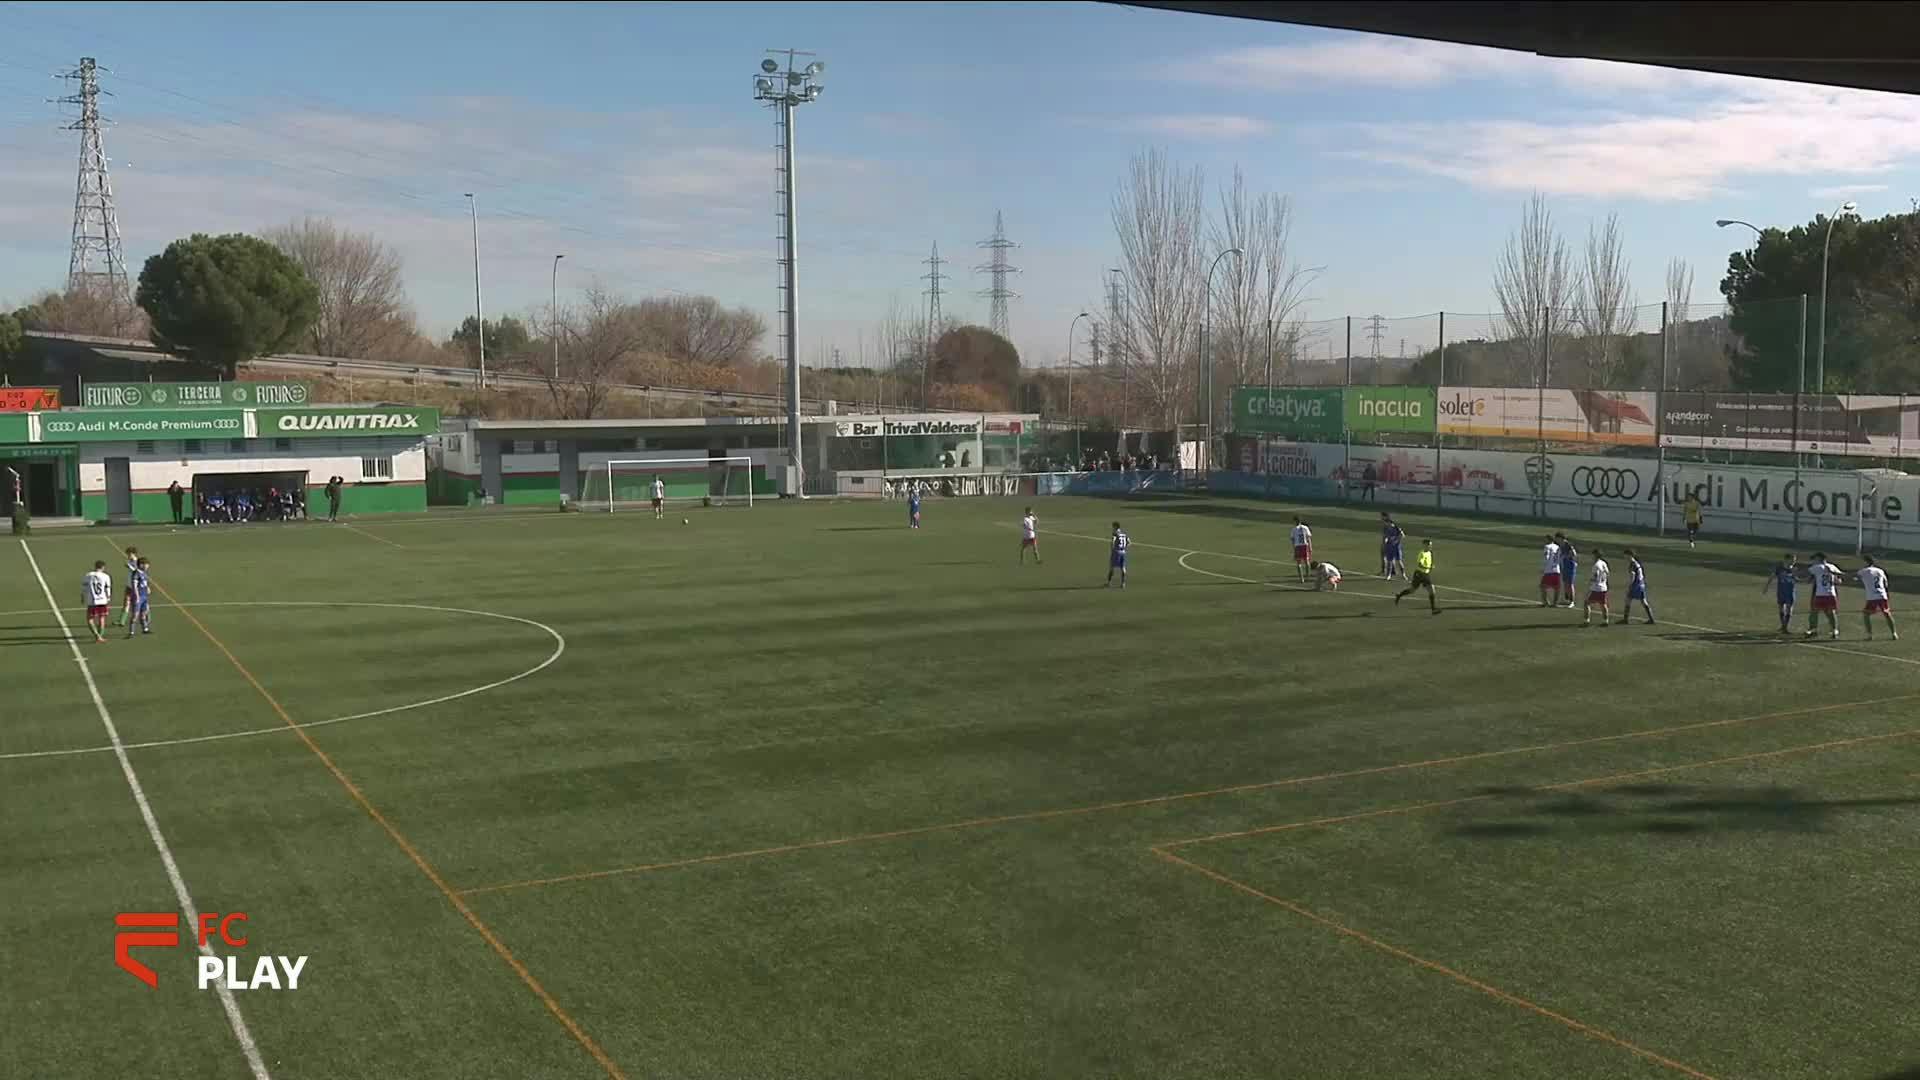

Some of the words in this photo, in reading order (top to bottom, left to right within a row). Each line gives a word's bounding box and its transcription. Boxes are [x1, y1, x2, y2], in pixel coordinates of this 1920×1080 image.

[178, 386, 221, 399] TERCERA
[1359, 394, 1422, 417] inacua
[77, 421, 105, 432] Audi
[109, 420, 158, 431] M.Conde
[161, 419, 212, 430] Premium
[278, 414, 419, 431] QUAMTRAX
[853, 423, 878, 435] Bar
[1648, 470, 1723, 508] Audi
